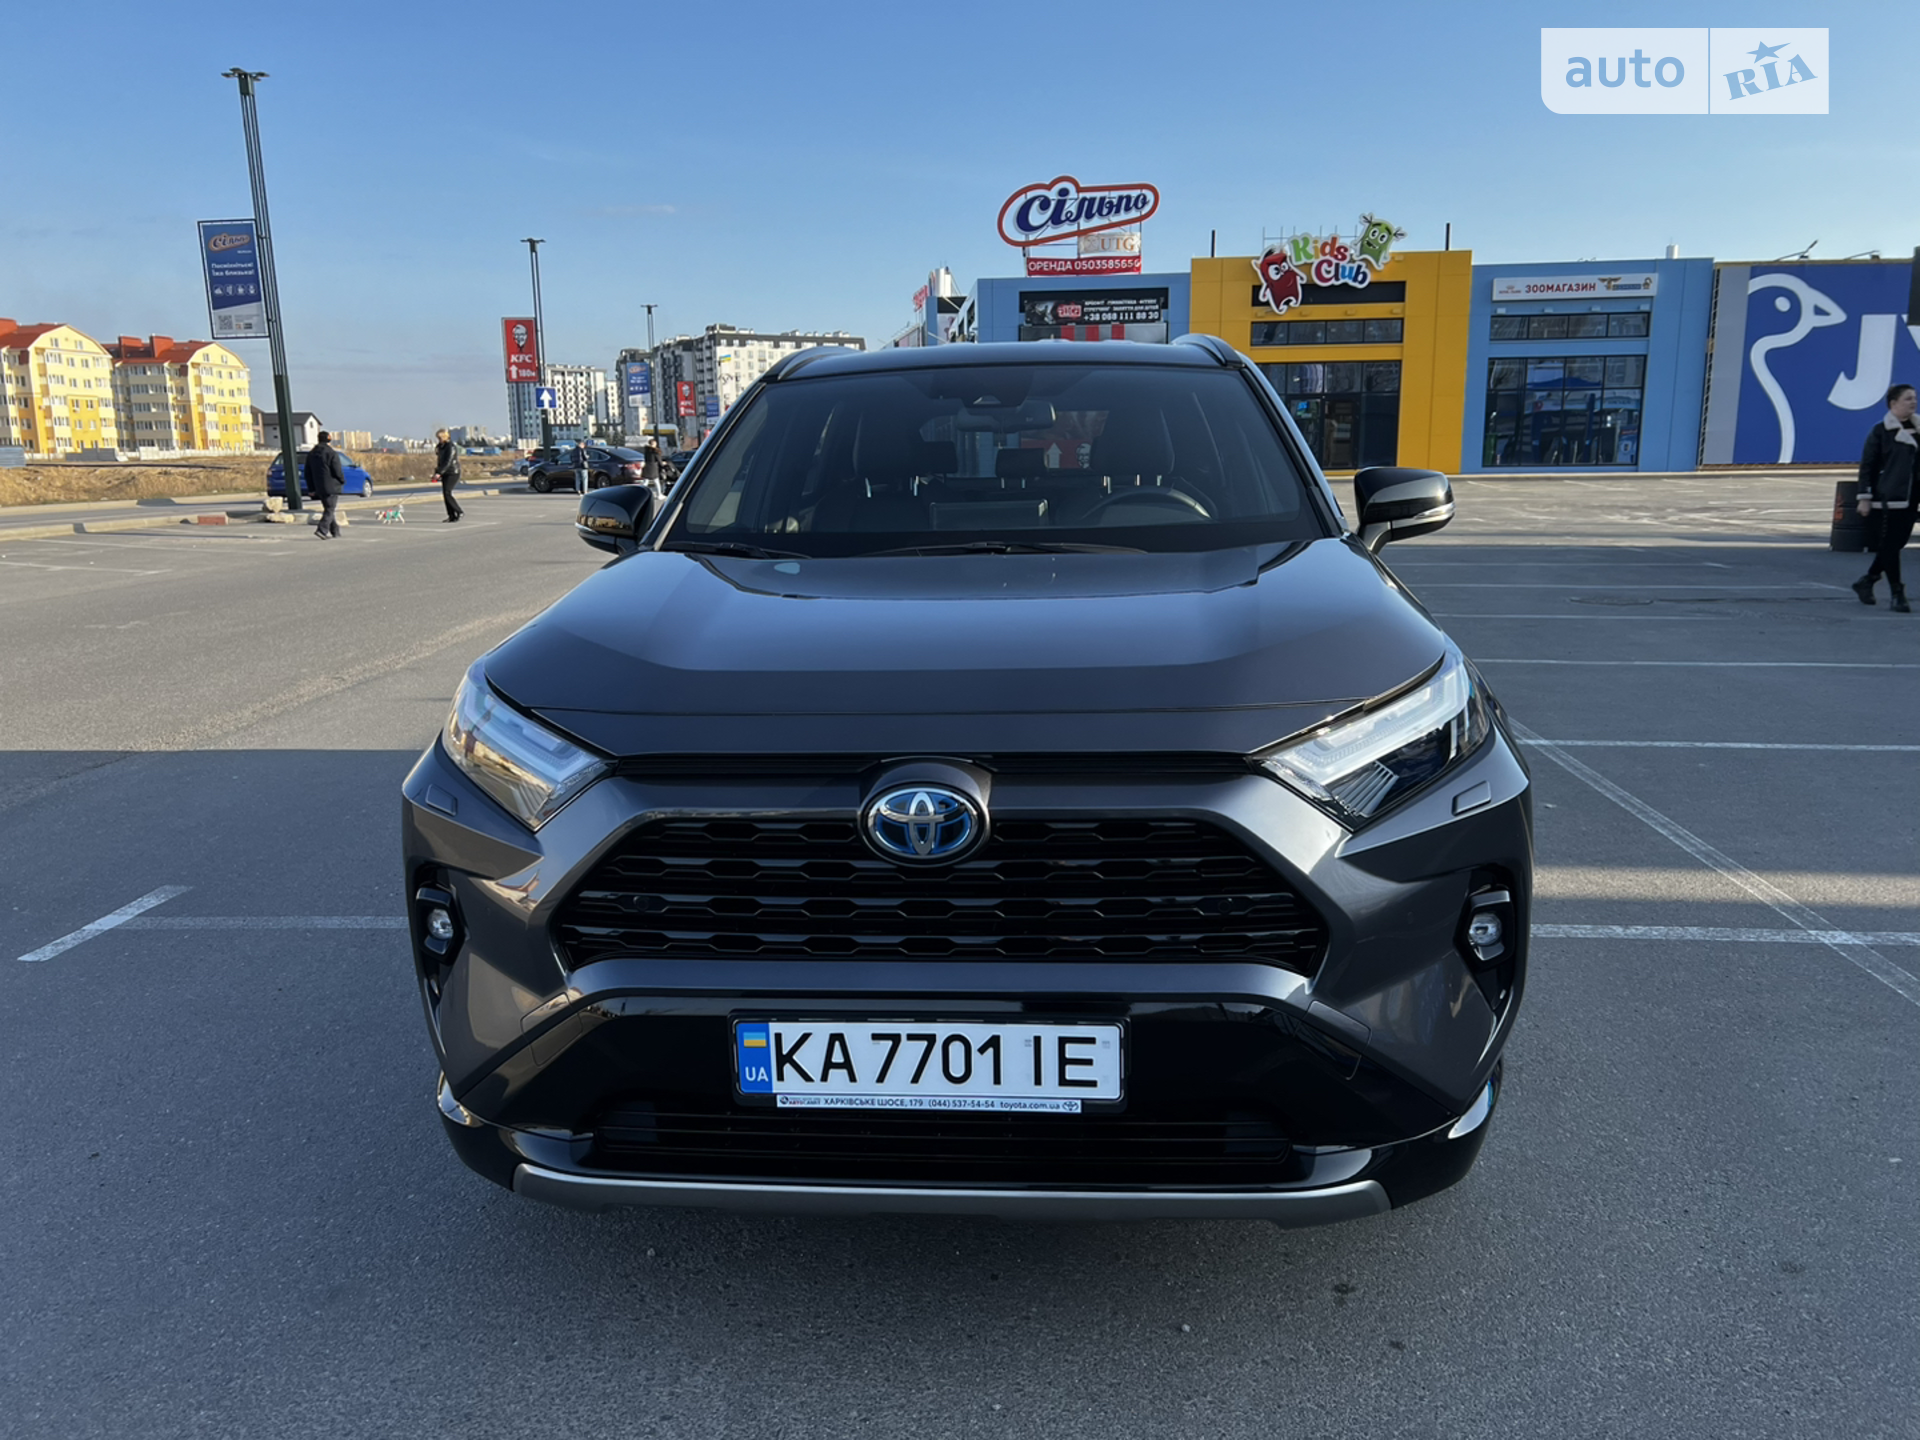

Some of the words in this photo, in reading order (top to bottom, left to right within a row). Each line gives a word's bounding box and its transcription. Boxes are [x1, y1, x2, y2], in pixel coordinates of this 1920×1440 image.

[1016, 187, 1149, 233] Сільпо
[1290, 236, 1349, 262] Kids
[1028, 260, 1073, 272] ОРЕНДА
[1315, 259, 1368, 284] Club
[1525, 282, 1596, 294] ЗООМАГАЗИН
[510, 354, 533, 363] KFC
[773, 1032, 858, 1083] KA
[870, 1032, 1002, 1085] 7701
[1033, 1035, 1098, 1087] IE
[745, 1066, 768, 1082] UA
[823, 1097, 876, 1106] ХАРКІВСЬКЕ
[909, 1099, 924, 1107] 179
[928, 1099, 951, 1108] (044)
[952, 1100, 995, 1108] 537-54-54
[1000, 1101, 1060, 1111] toyota.com.ua
